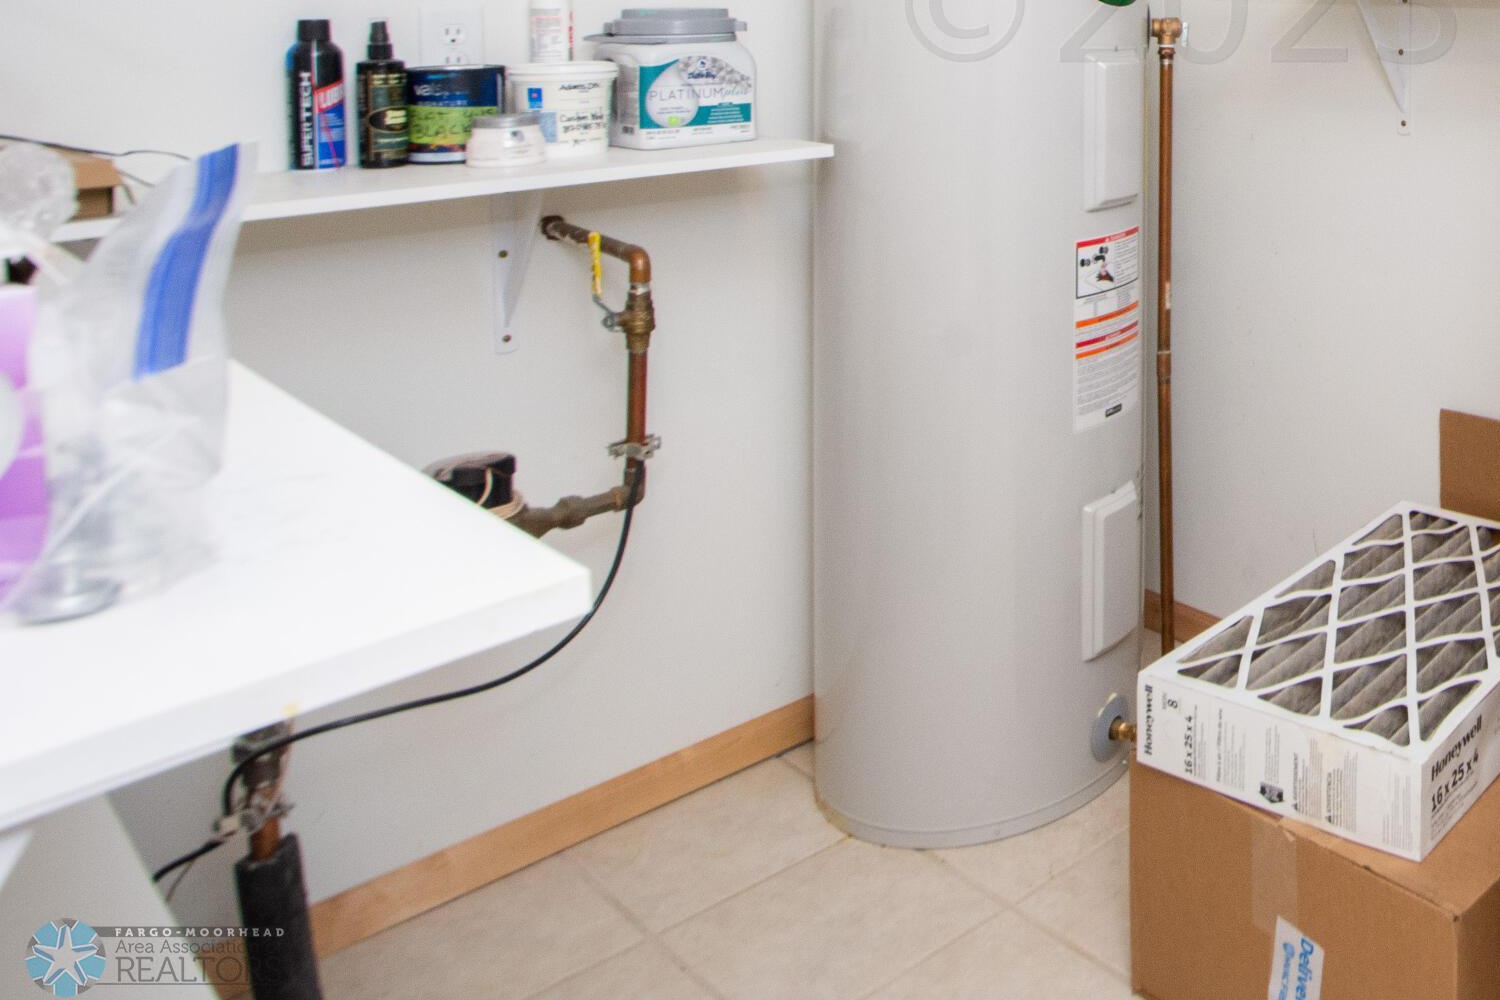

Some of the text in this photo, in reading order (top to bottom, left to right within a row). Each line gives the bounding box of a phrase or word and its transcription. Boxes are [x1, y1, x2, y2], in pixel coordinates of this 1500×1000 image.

[1143, 684, 1154, 755] Honeywell
[1184, 733, 1193, 749] 25
[1184, 759, 1193, 774] 16
[1431, 714, 1483, 782] Honeywell
[1432, 786, 1443, 813] 16
[1451, 763, 1465, 788] 25
